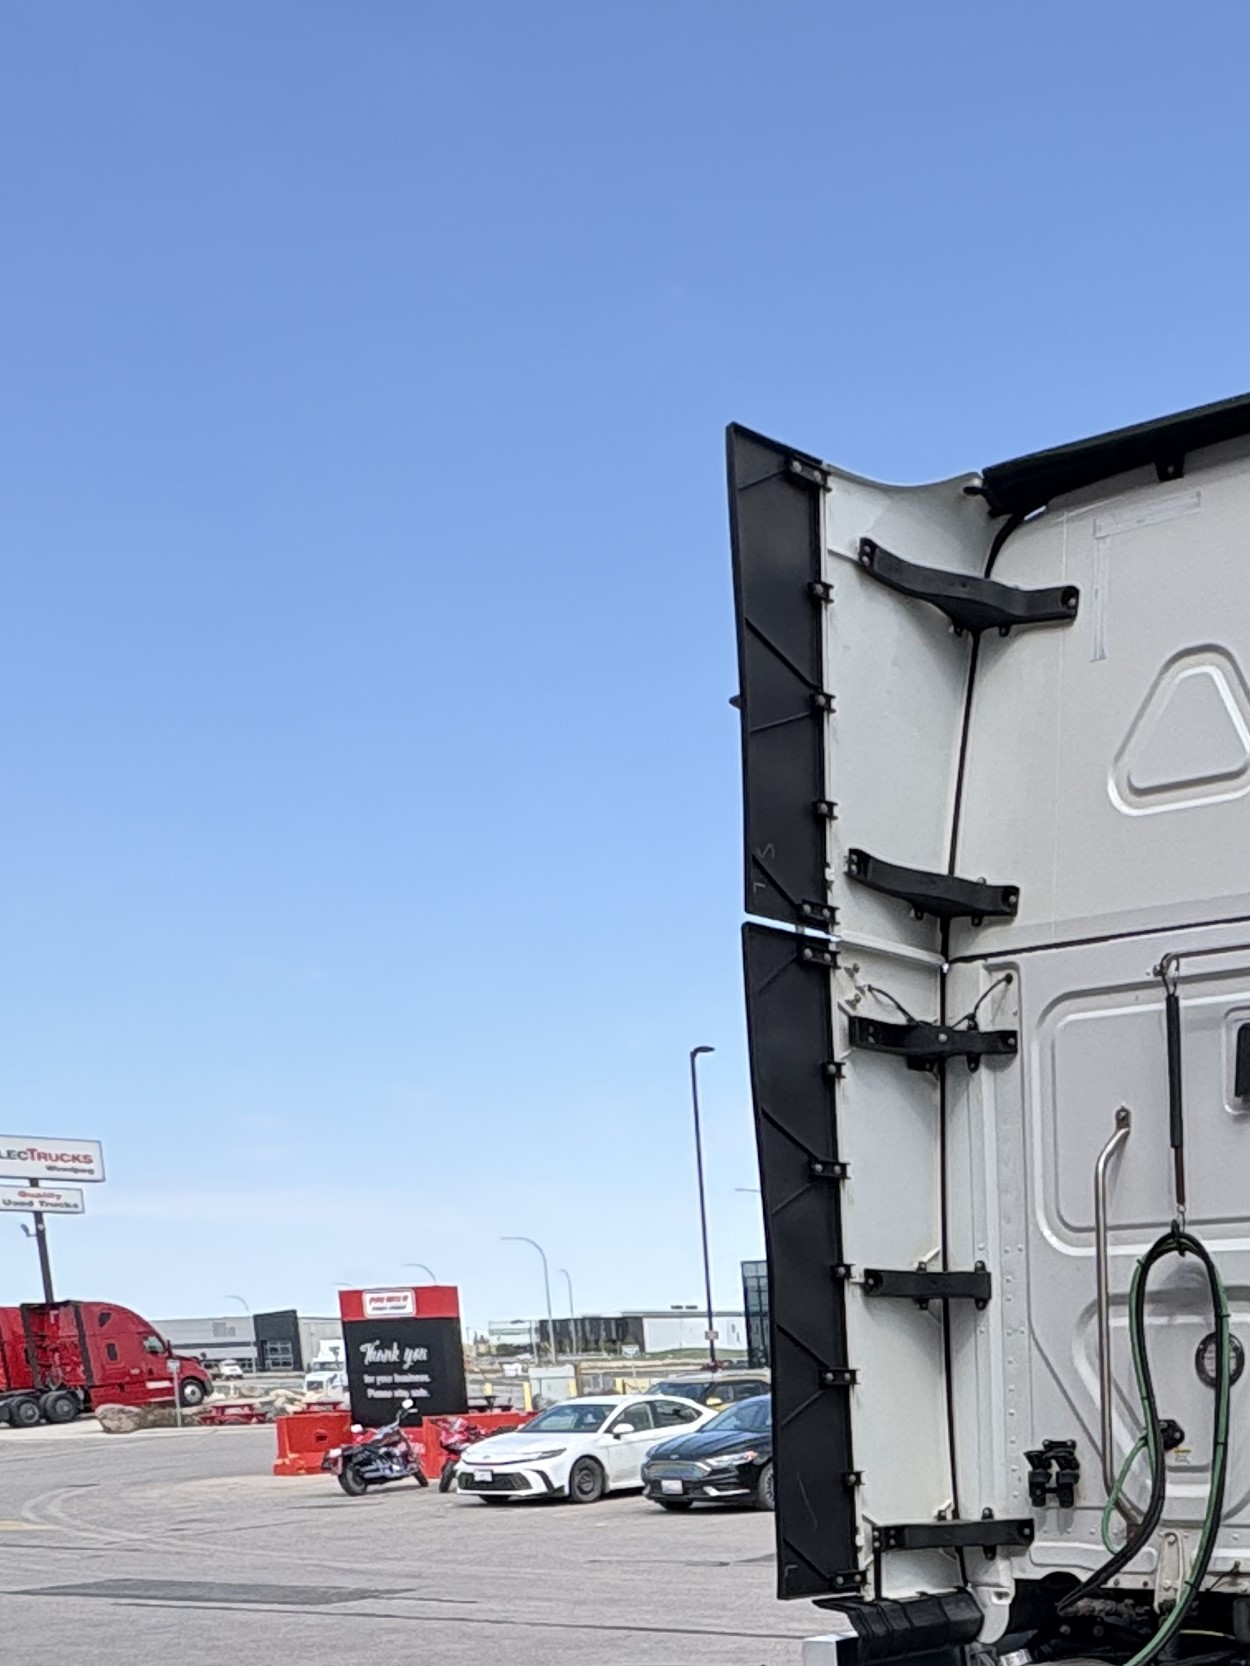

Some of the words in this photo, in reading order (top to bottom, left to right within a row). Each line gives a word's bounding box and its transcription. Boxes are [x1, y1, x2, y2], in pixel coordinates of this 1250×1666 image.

[2, 1199, 35, 1207] Used
[38, 1200, 79, 1209] Trucks
[359, 1339, 401, 1366] Thank
[402, 1346, 429, 1370] you
